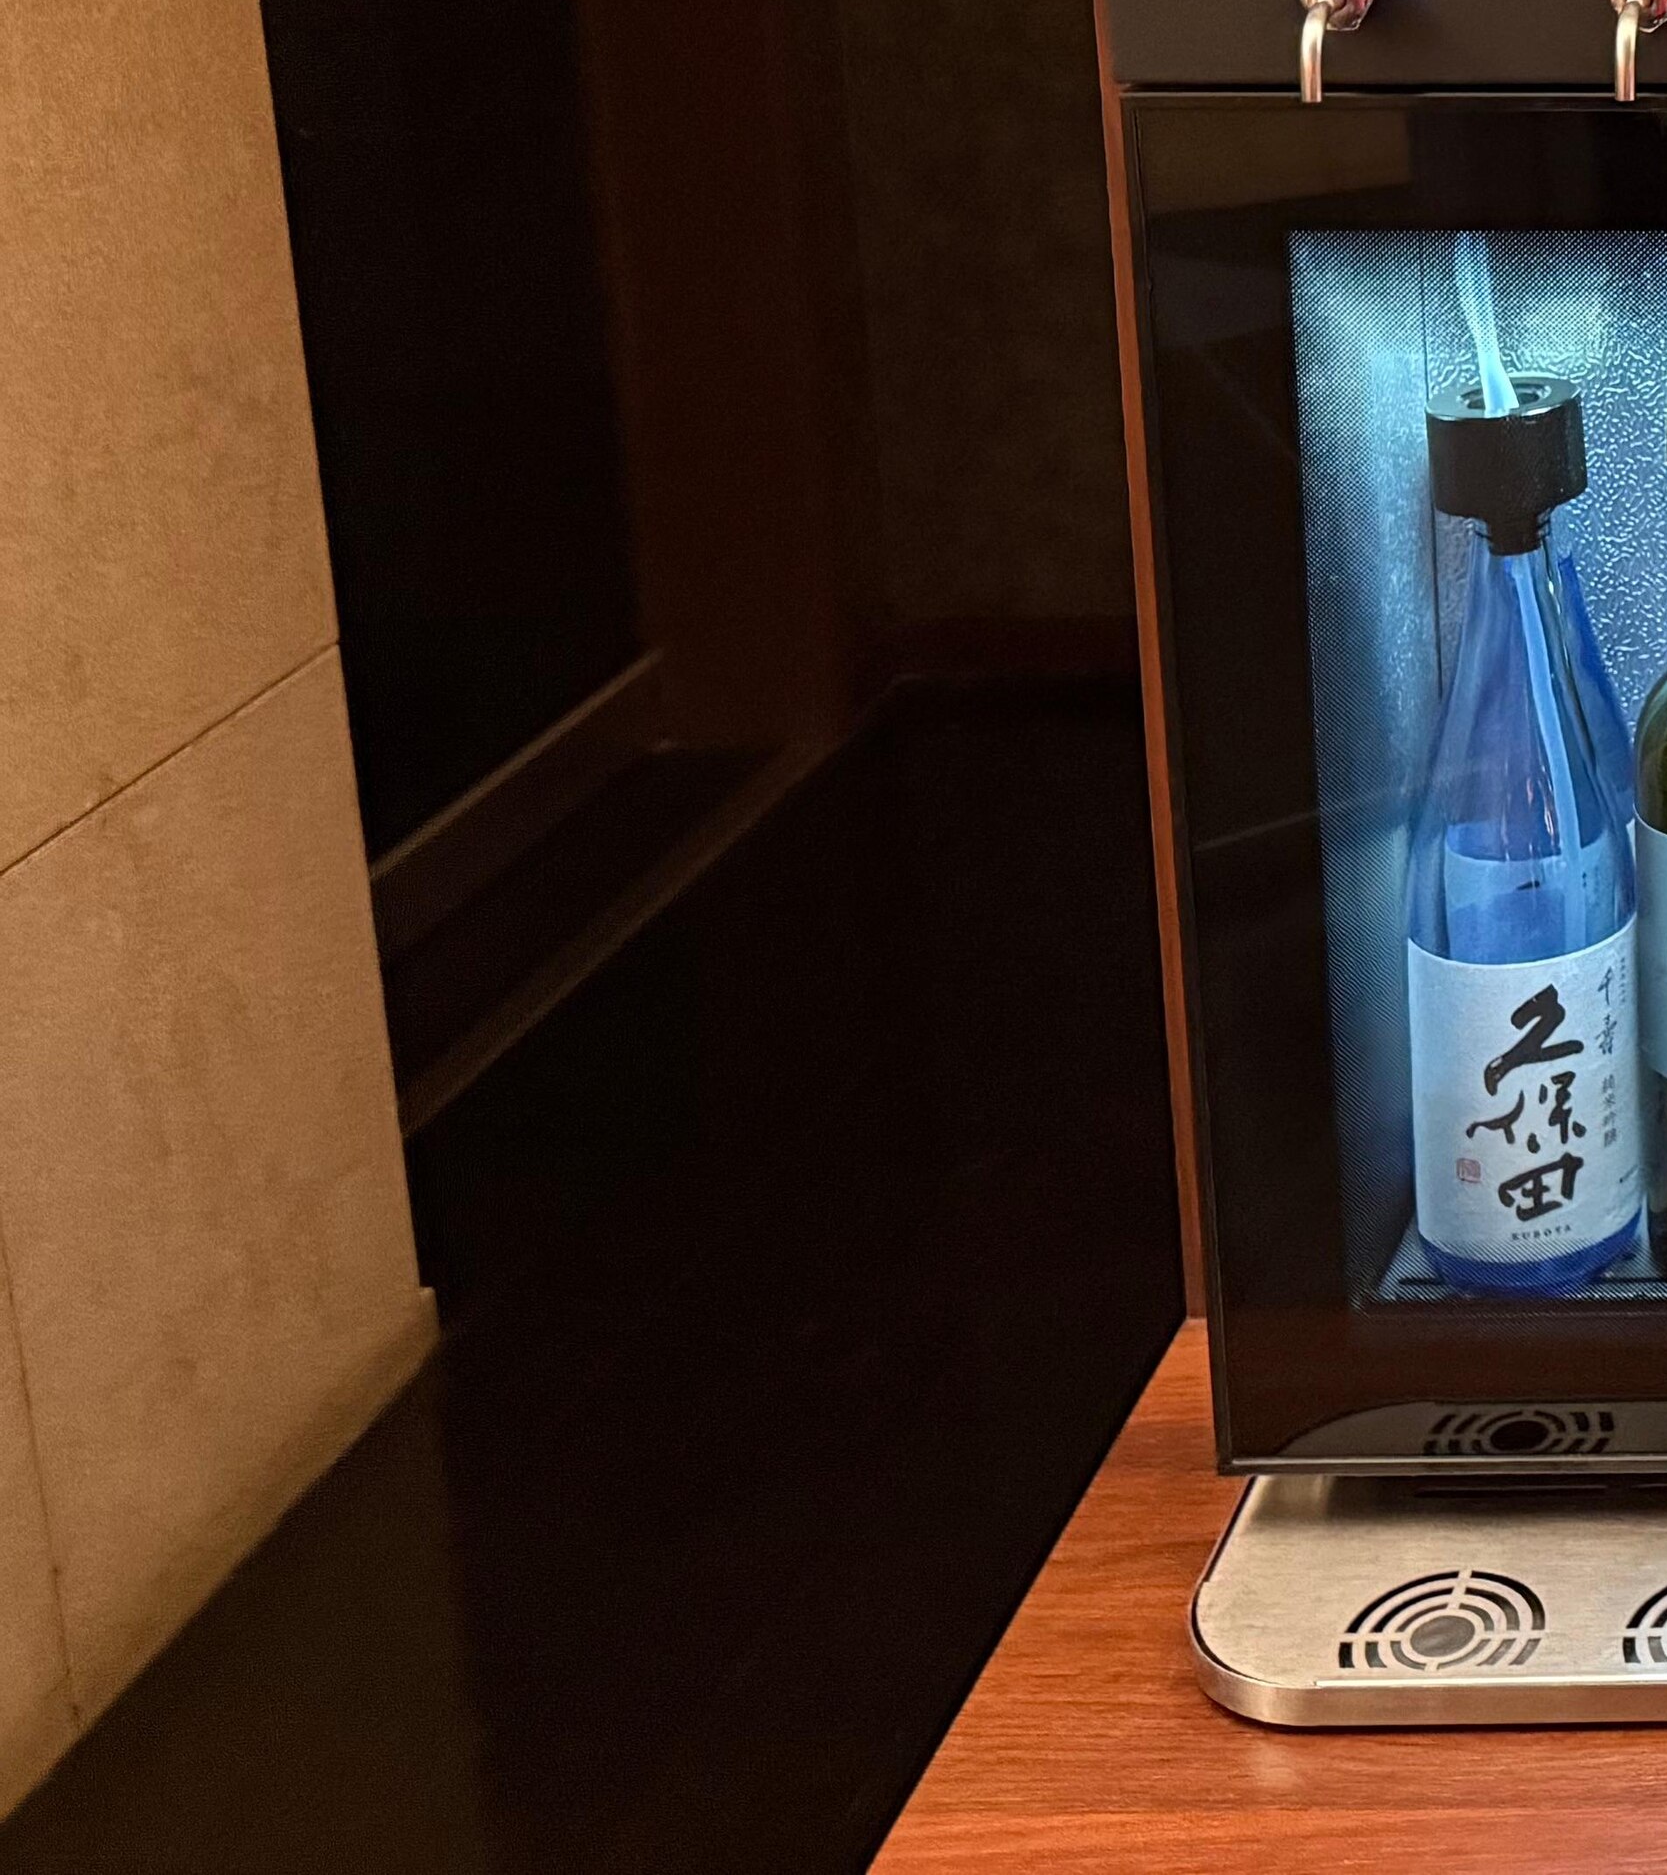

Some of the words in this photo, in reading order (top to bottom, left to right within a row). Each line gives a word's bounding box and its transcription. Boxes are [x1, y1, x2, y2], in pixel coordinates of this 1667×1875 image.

[1465, 982, 1587, 1223] 久保田
[1511, 1224, 1573, 1242] KUBOTA
